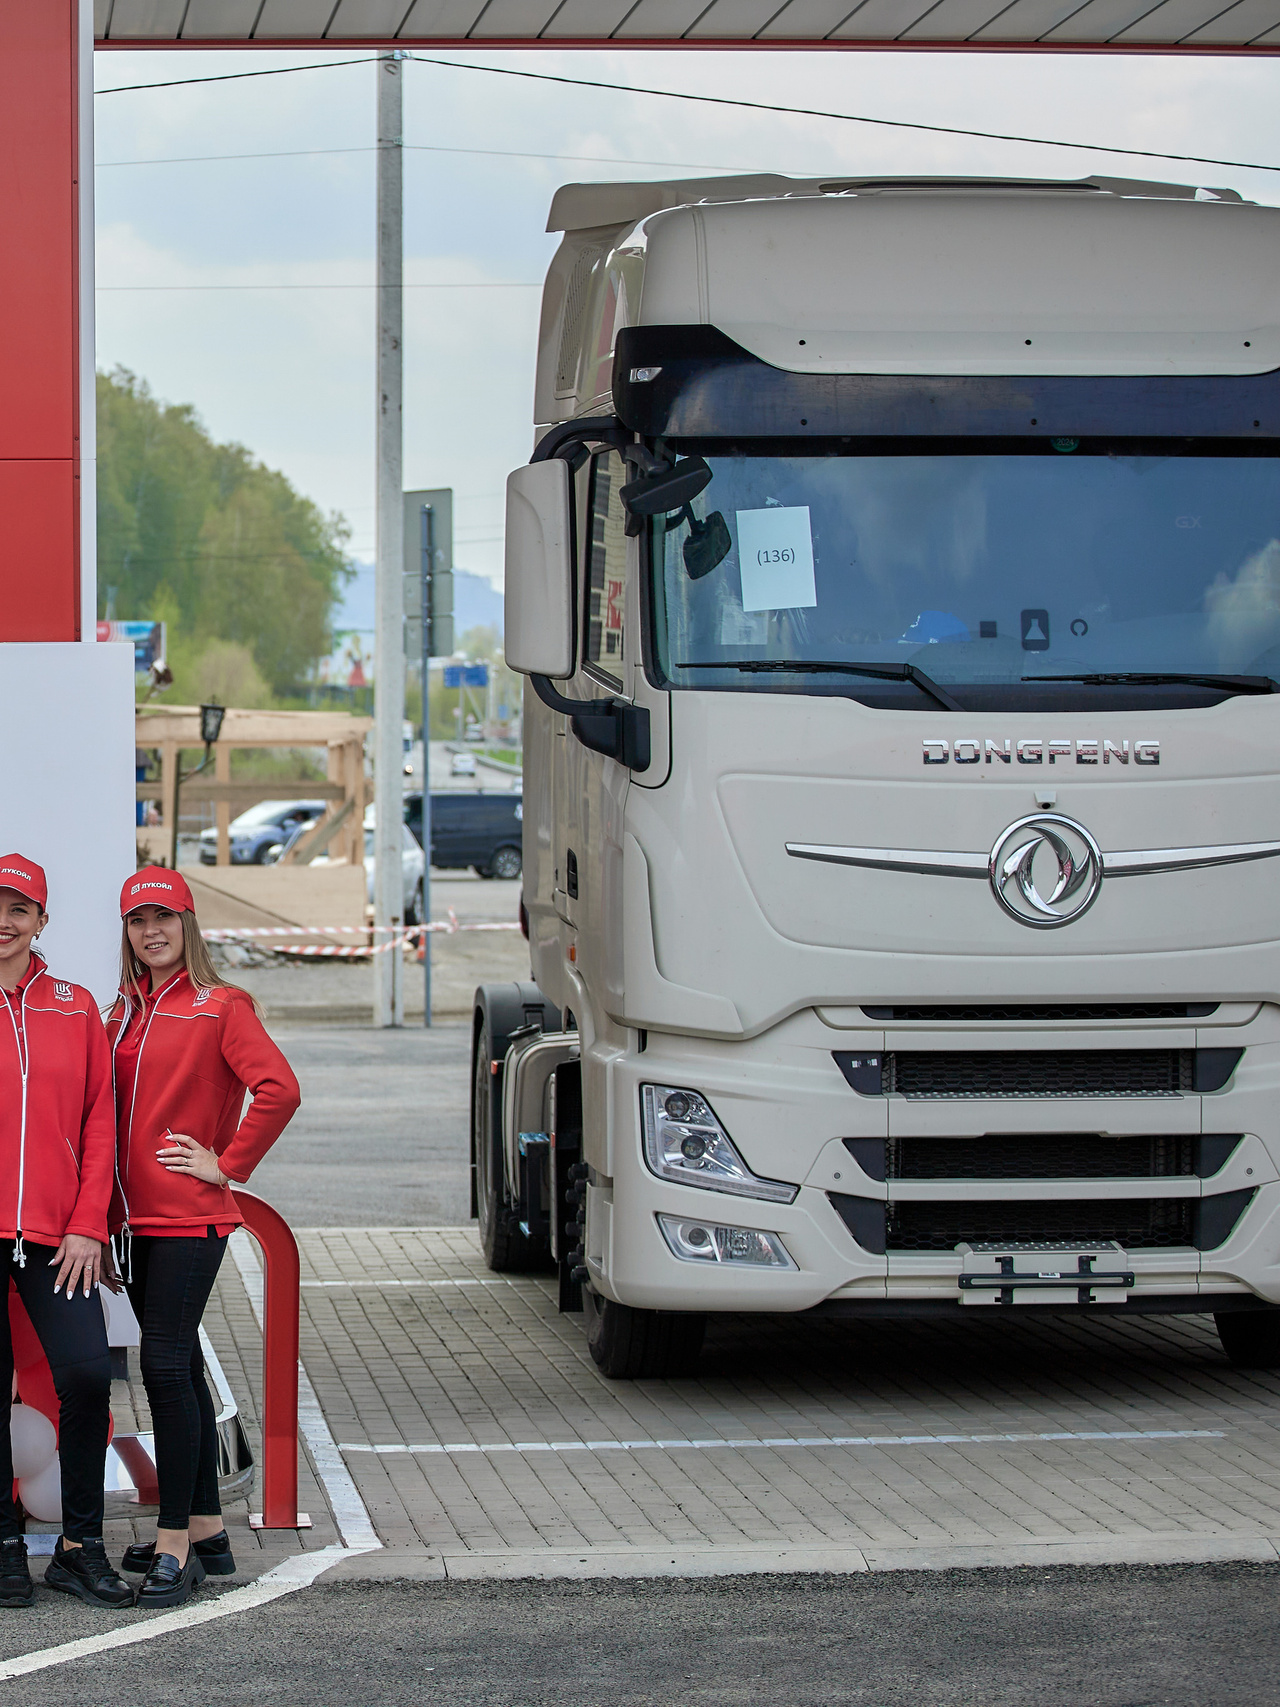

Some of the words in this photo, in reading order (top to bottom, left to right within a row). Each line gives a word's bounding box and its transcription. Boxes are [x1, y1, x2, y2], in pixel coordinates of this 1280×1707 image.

[757, 548, 795, 566] (136)
[922, 739, 1160, 766] DONGFENG
[1, 868, 32, 881] ЛУКОЙЛ
[141, 882, 172, 891] ЛУКОЙЛ
